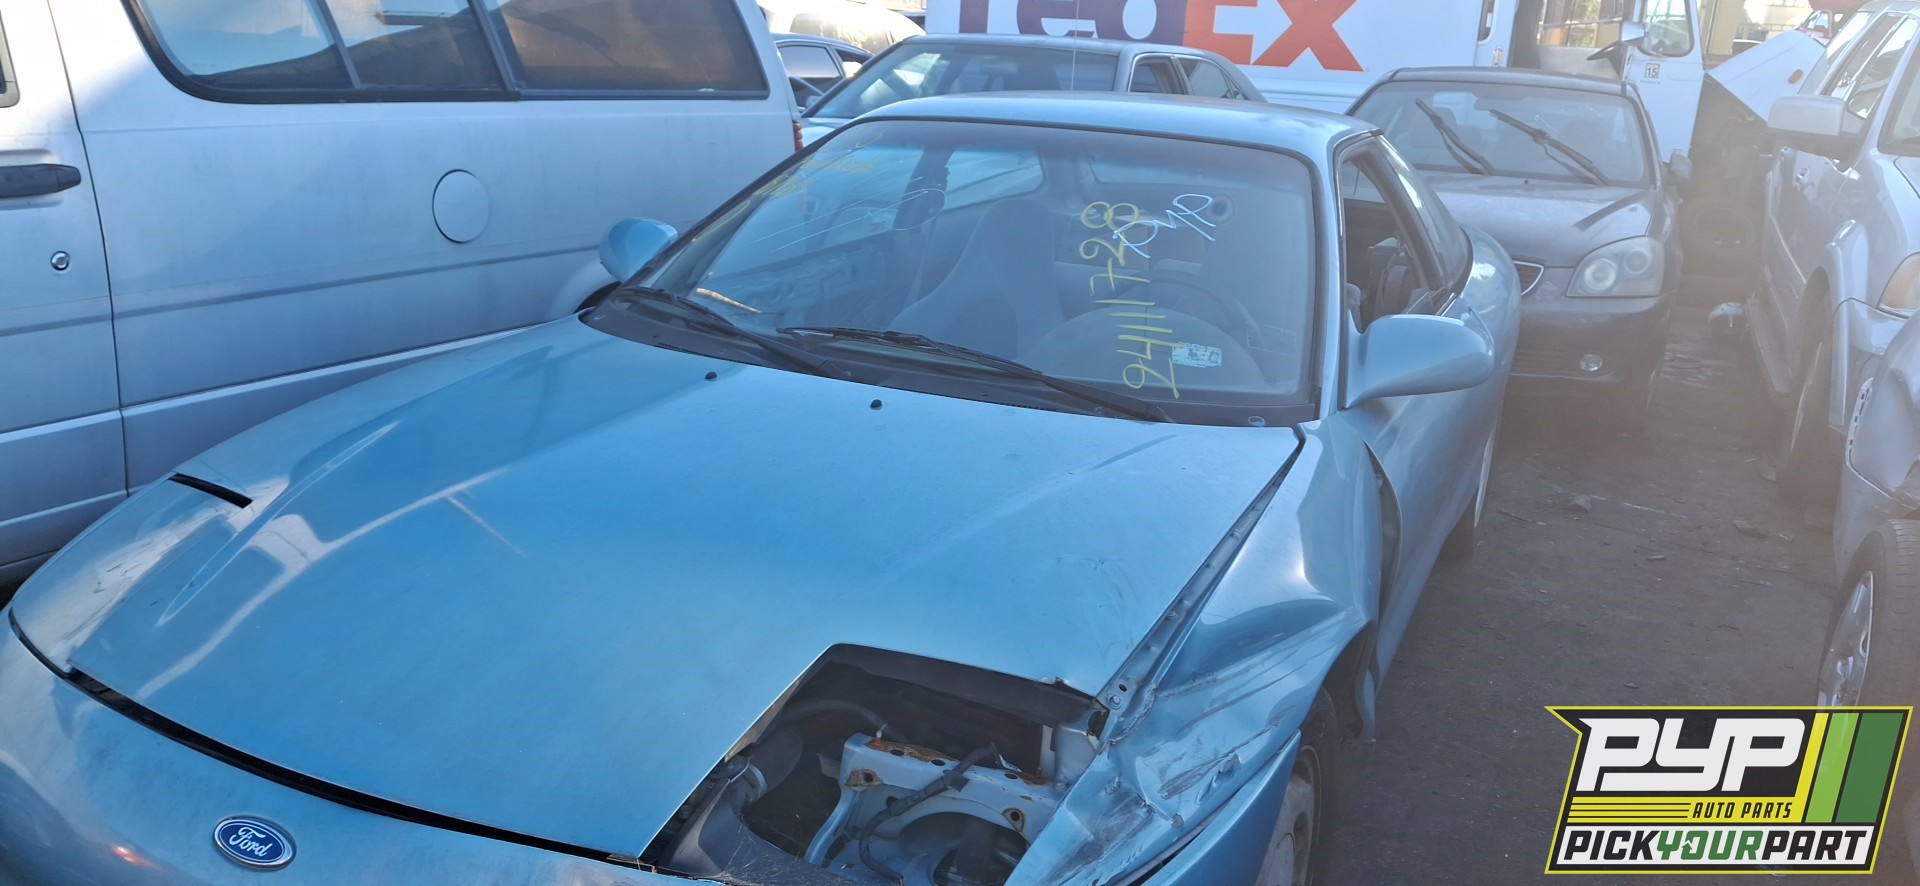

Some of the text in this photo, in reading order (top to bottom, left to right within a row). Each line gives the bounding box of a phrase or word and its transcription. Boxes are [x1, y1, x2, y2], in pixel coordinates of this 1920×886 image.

[1647, 67, 1658, 77] 15
[1079, 200, 1186, 400] 24111728
[228, 826, 273, 857] Ford
